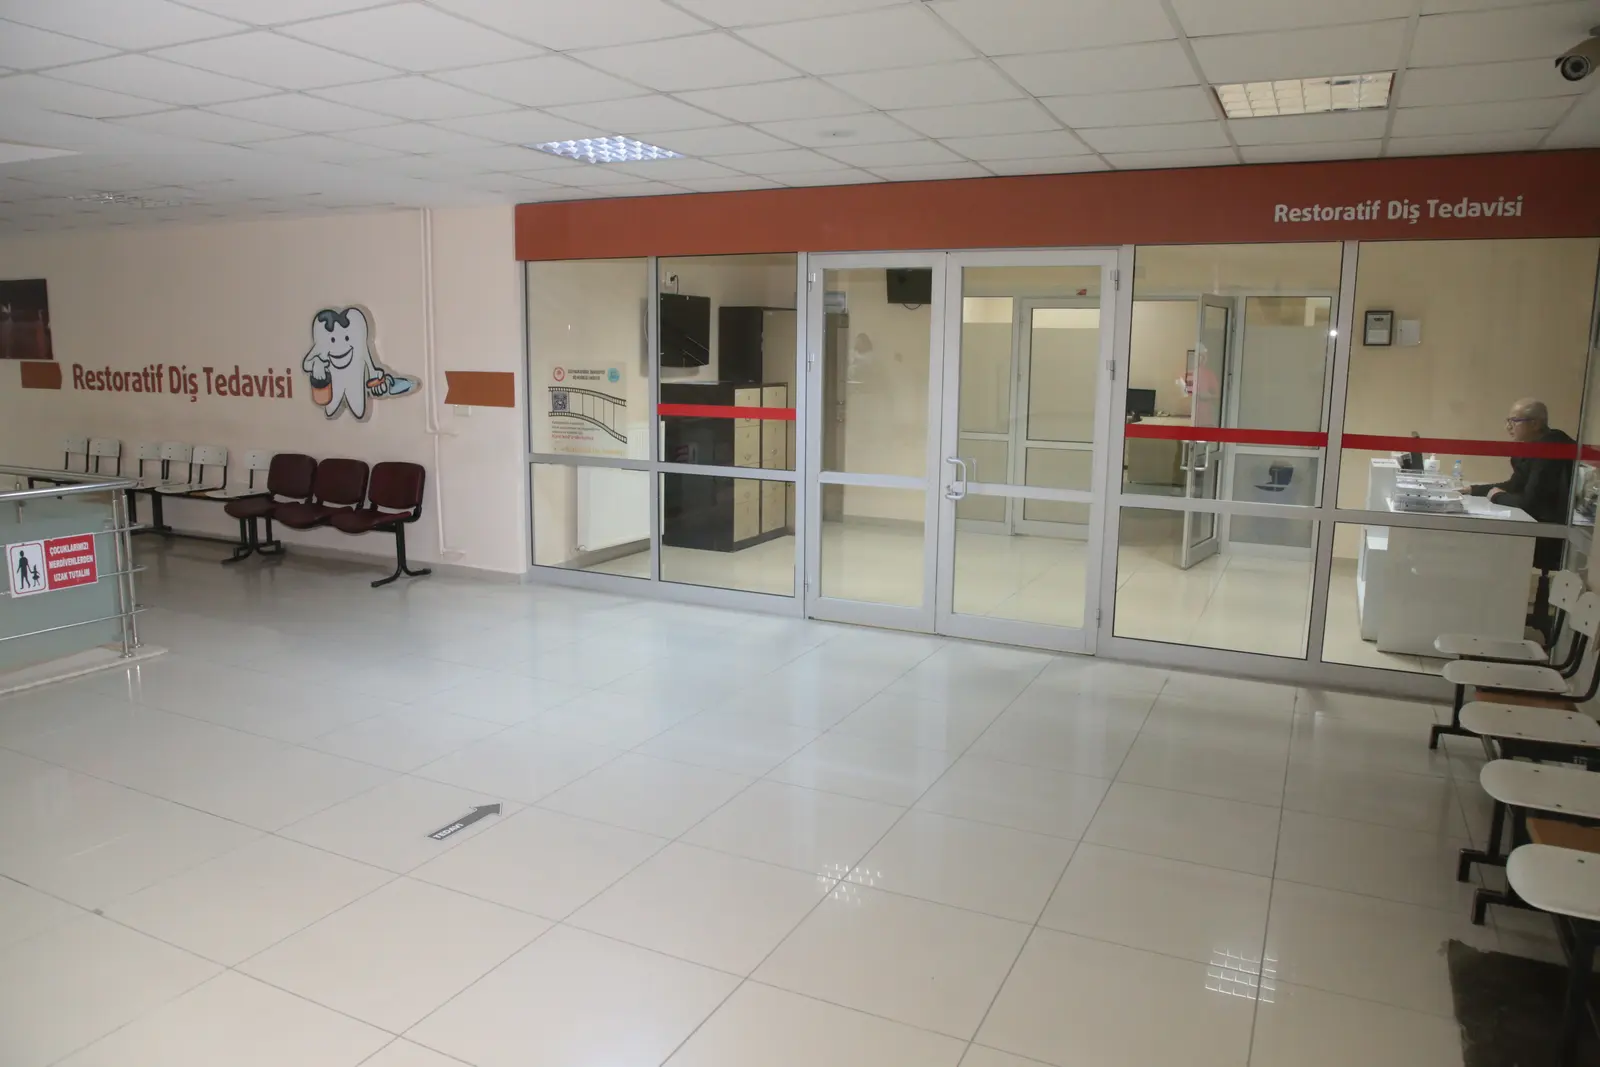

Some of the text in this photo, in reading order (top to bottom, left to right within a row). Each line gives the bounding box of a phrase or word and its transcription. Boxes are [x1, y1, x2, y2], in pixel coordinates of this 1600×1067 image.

[1274, 195, 1523, 224] Restoratif Diş Tedavisi
[72, 363, 293, 403] Restoratif Diş Tedavisi
[53, 568, 91, 582] UZAK TUTALIM
